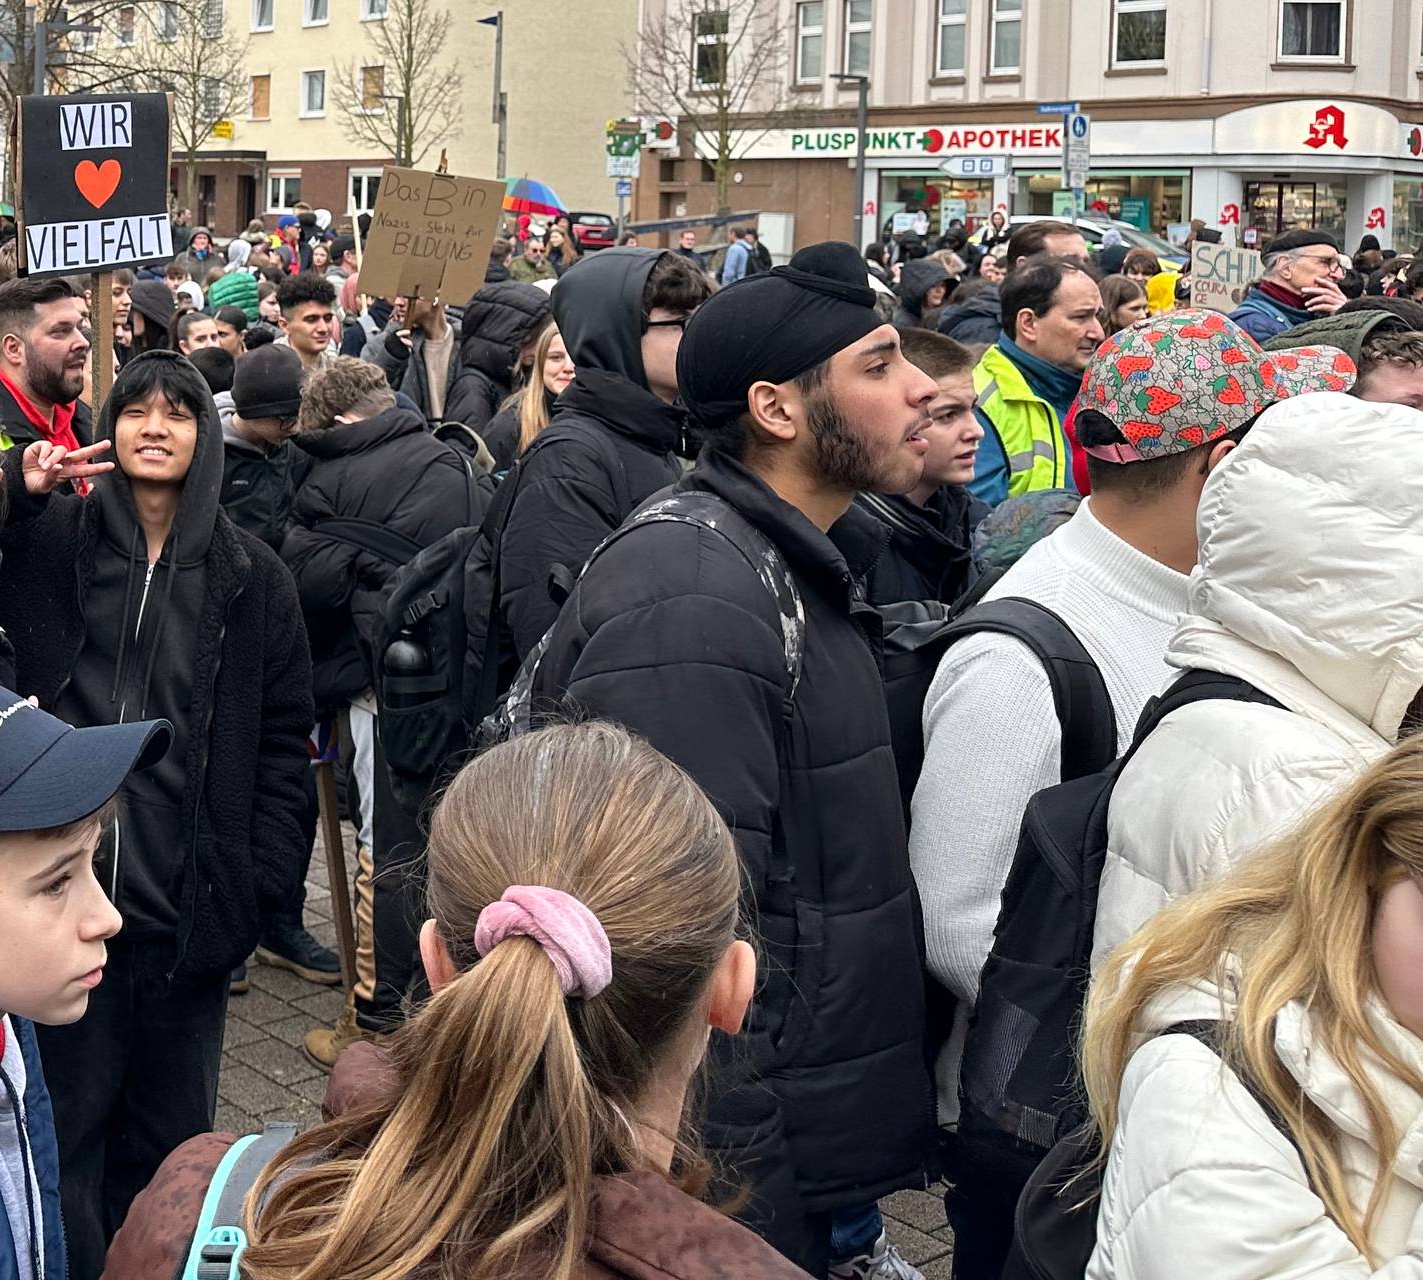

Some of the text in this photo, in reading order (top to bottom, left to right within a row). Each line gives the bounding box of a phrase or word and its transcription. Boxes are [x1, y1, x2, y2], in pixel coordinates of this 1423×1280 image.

[60, 103, 130, 148] WIR
[946, 129, 1062, 148] APOTHEK
[383, 172, 487, 217] Das B in
[377, 211, 410, 229] Nazis
[27, 215, 167, 270] VIELFALT
[392, 232, 473, 261] BILDUNG
